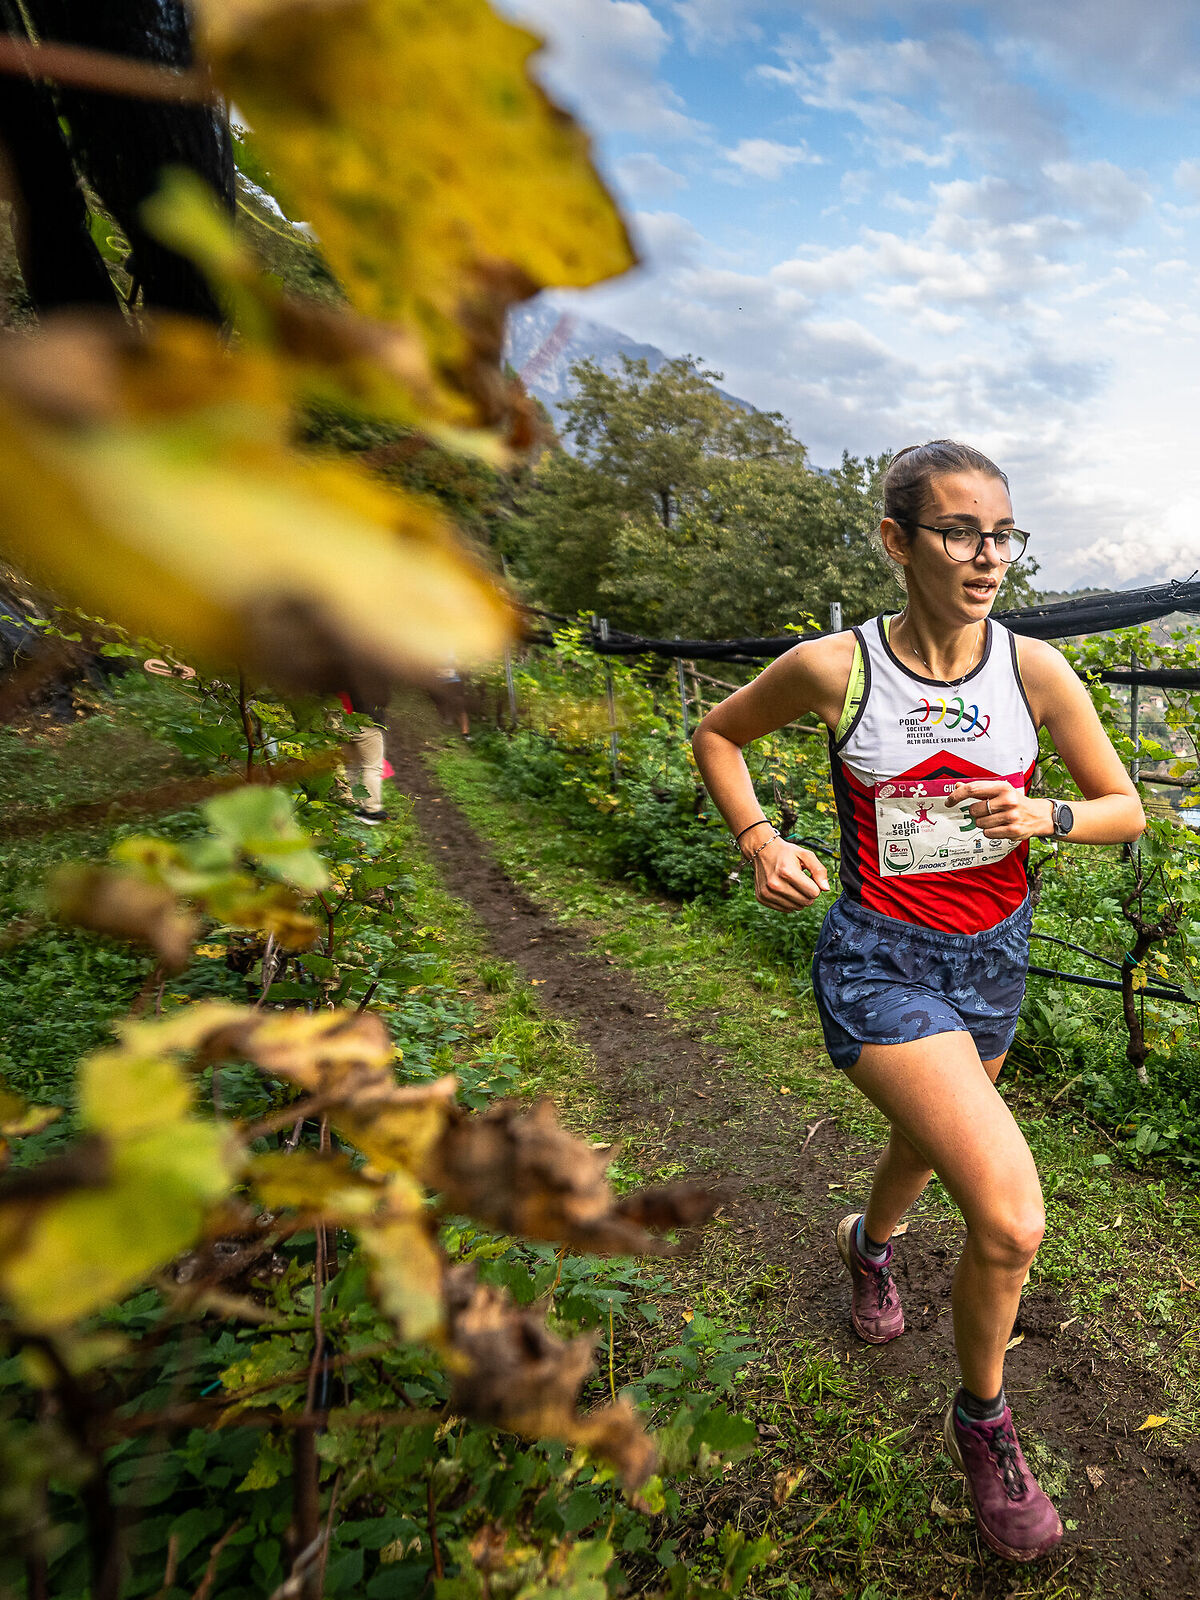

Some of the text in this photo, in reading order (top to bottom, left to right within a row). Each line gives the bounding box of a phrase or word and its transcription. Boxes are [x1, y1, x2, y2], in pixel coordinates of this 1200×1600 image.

[899, 718, 919, 726] POOL
[892, 821, 916, 830] valle
[892, 826, 920, 837] segni
[918, 861, 946, 870] BROOKS
